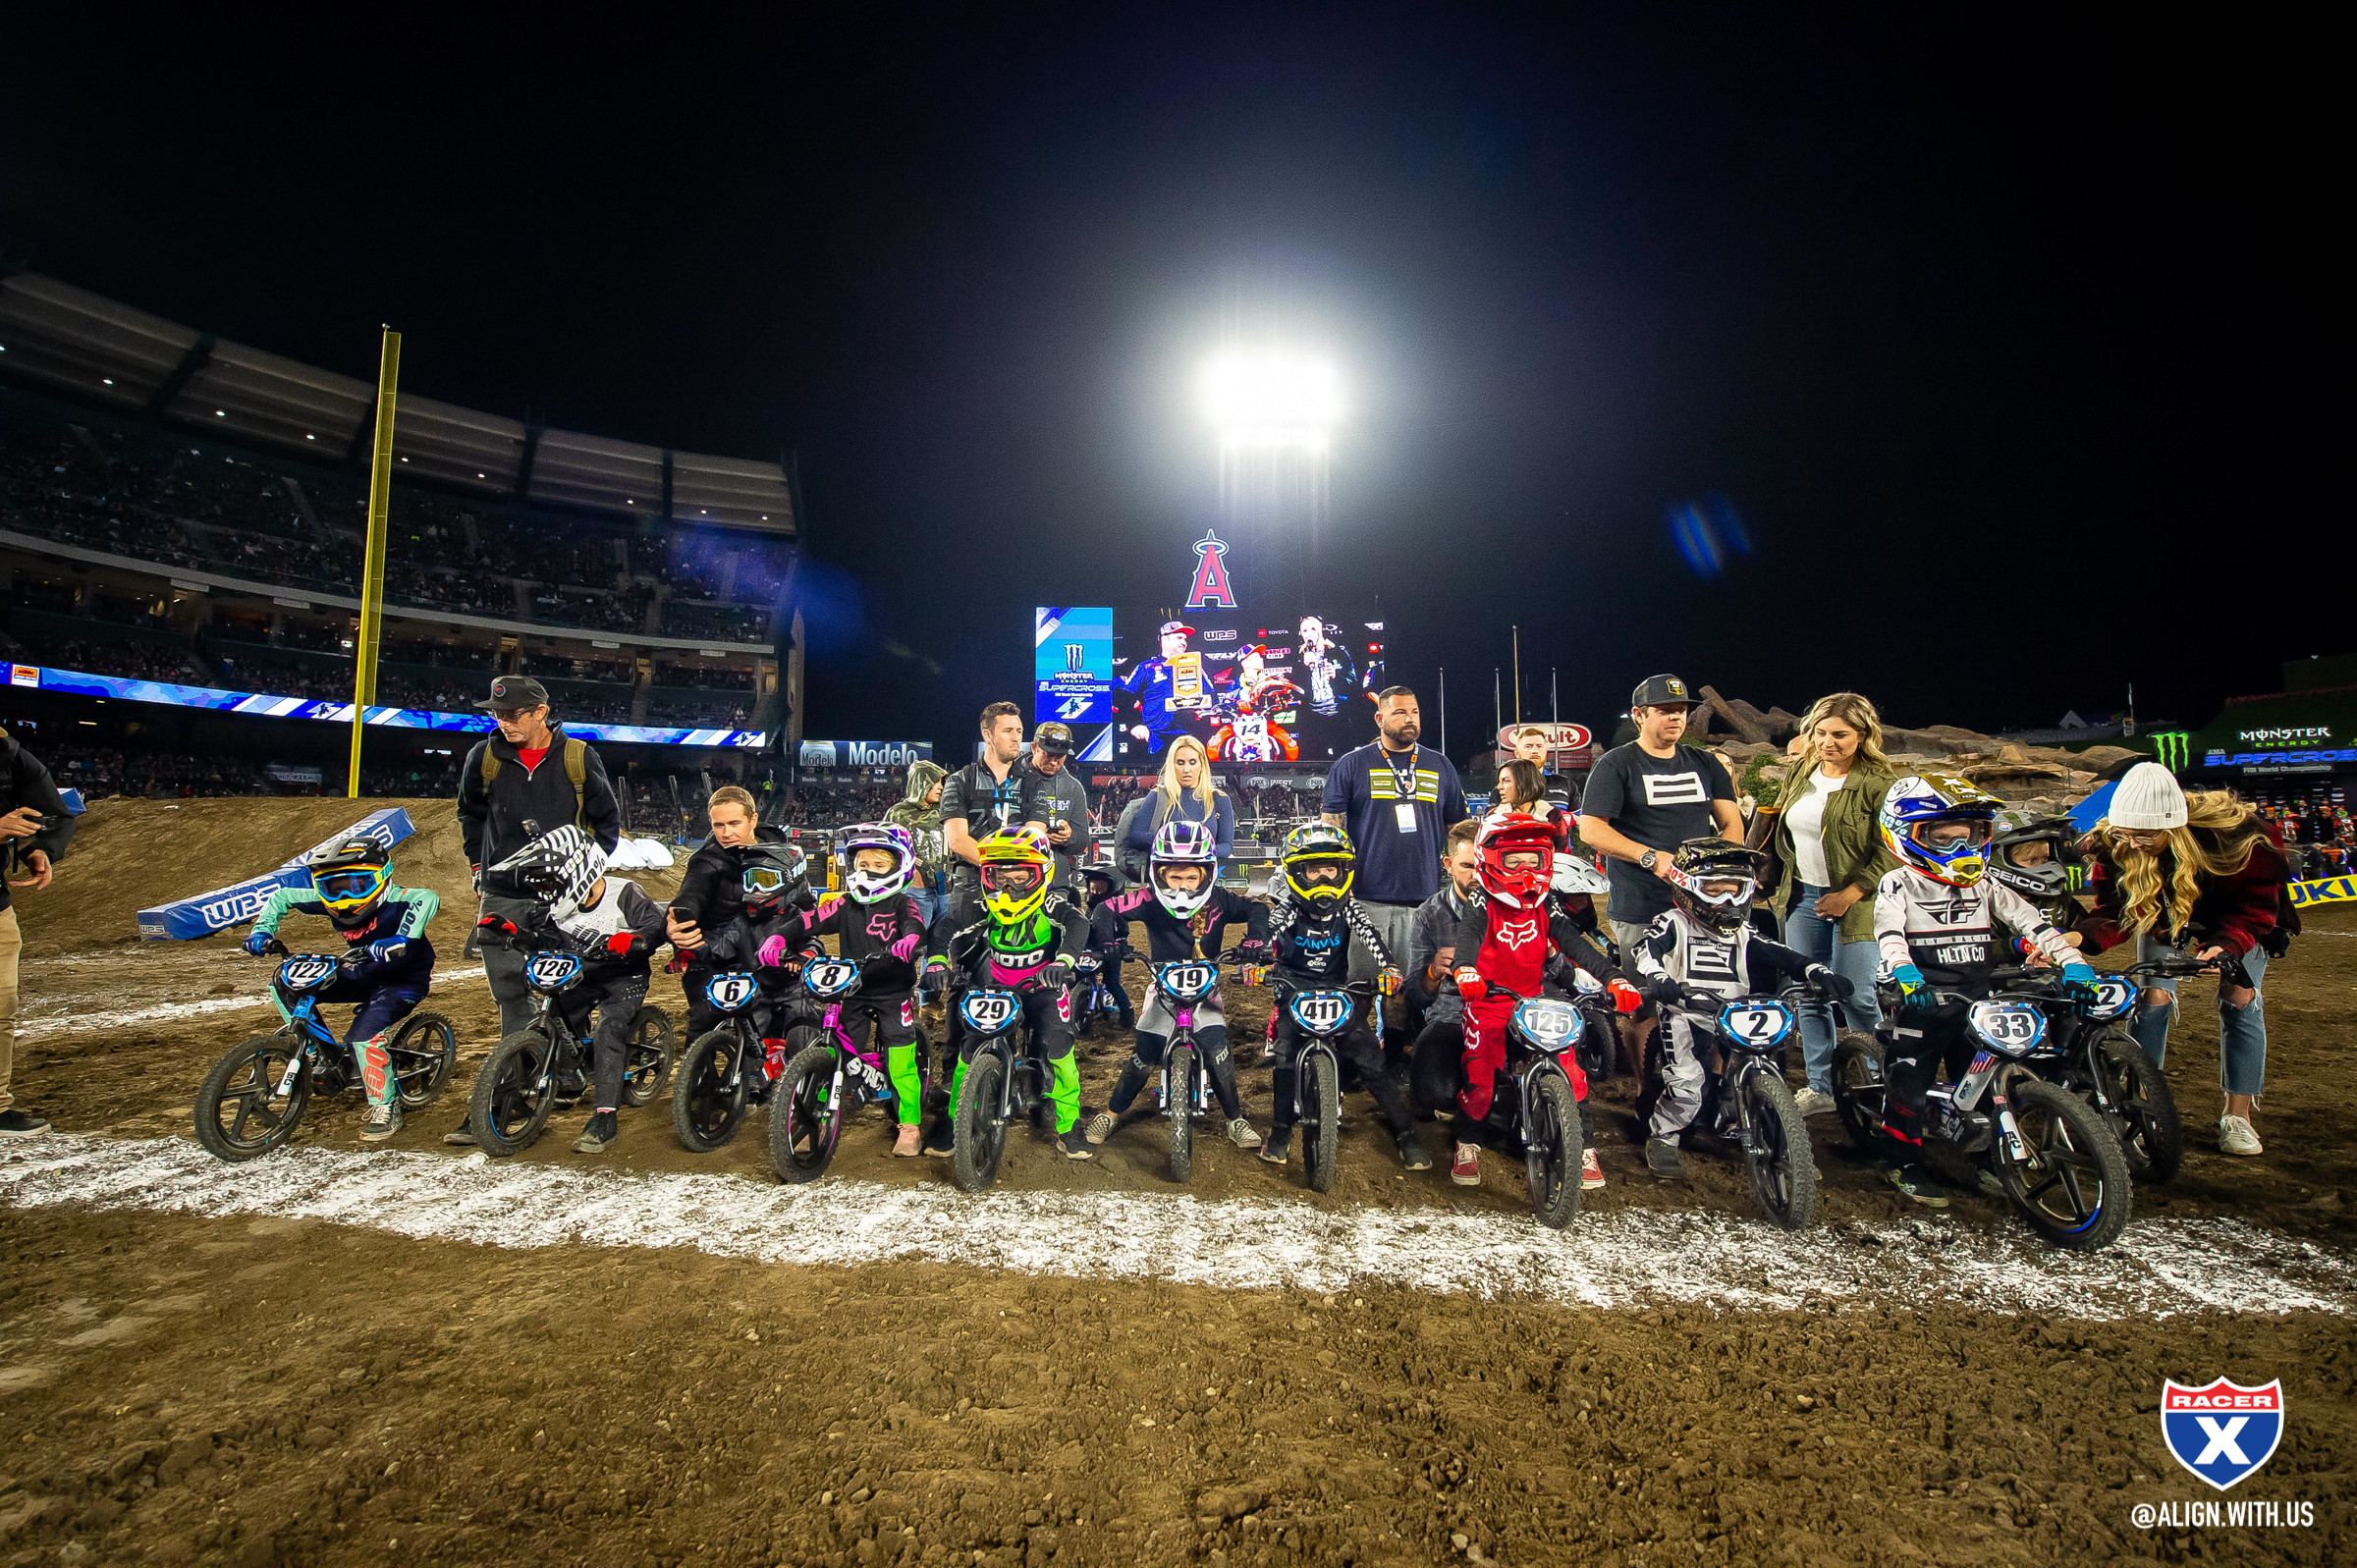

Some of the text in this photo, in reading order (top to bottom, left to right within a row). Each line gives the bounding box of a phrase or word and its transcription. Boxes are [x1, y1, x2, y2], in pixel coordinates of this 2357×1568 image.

[1204, 629, 1237, 641] WPS
[1240, 725, 1261, 735] 14
[2239, 728, 2331, 741] MONSTER
[802, 752, 834, 766] Modelo
[849, 741, 918, 766] Modelo
[570, 855, 606, 903] 100%
[1987, 866, 2046, 892] GEICO
[139, 925, 165, 935] WPS
[1294, 934, 1341, 950] CANVAS
[1937, 946, 1985, 964] HLTN CO
[290, 963, 325, 978] 122
[539, 960, 572, 977] 128
[820, 966, 841, 987] 8
[1174, 969, 1202, 989] 19
[724, 982, 740, 1002] 6
[975, 1000, 1005, 1019] 29
[1304, 1001, 1339, 1019] 411
[1528, 1010, 1569, 1034] 125
[1748, 1011, 1769, 1037] 2
[1990, 1014, 2031, 1038] 33
[1131, 1053, 1146, 1070] FOX
[1215, 1046, 1230, 1065] FOX
